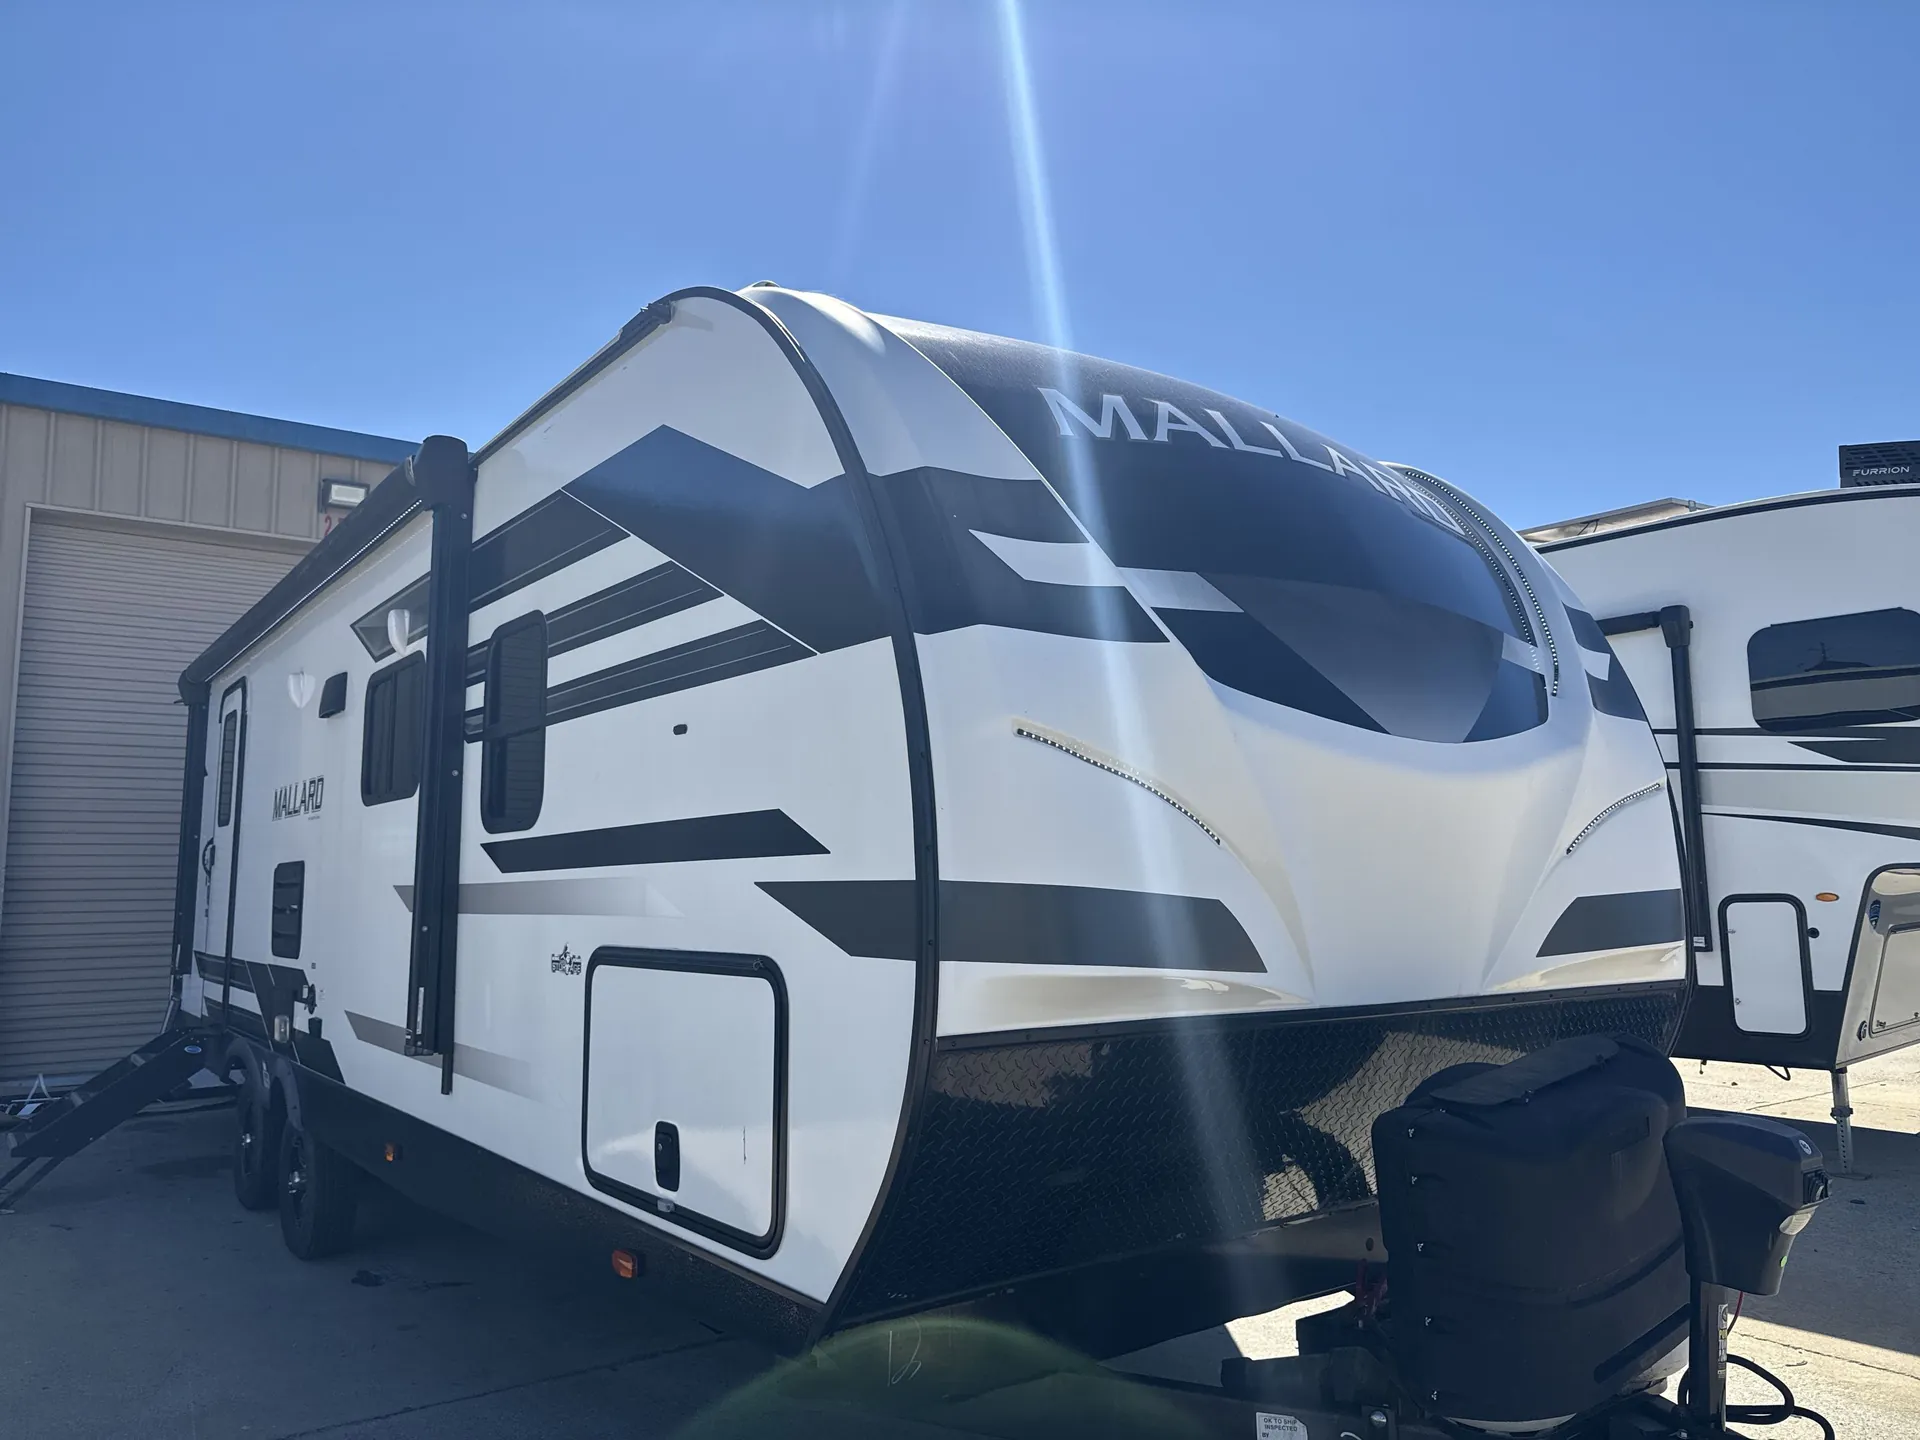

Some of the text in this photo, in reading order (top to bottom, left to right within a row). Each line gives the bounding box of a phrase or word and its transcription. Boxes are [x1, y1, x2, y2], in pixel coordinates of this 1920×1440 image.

[1038, 387, 1466, 535] MALLARD
[1852, 466, 1910, 477] FURRION
[272, 775, 324, 821] MALLARD
[1264, 1424, 1298, 1432] INSPECTED
